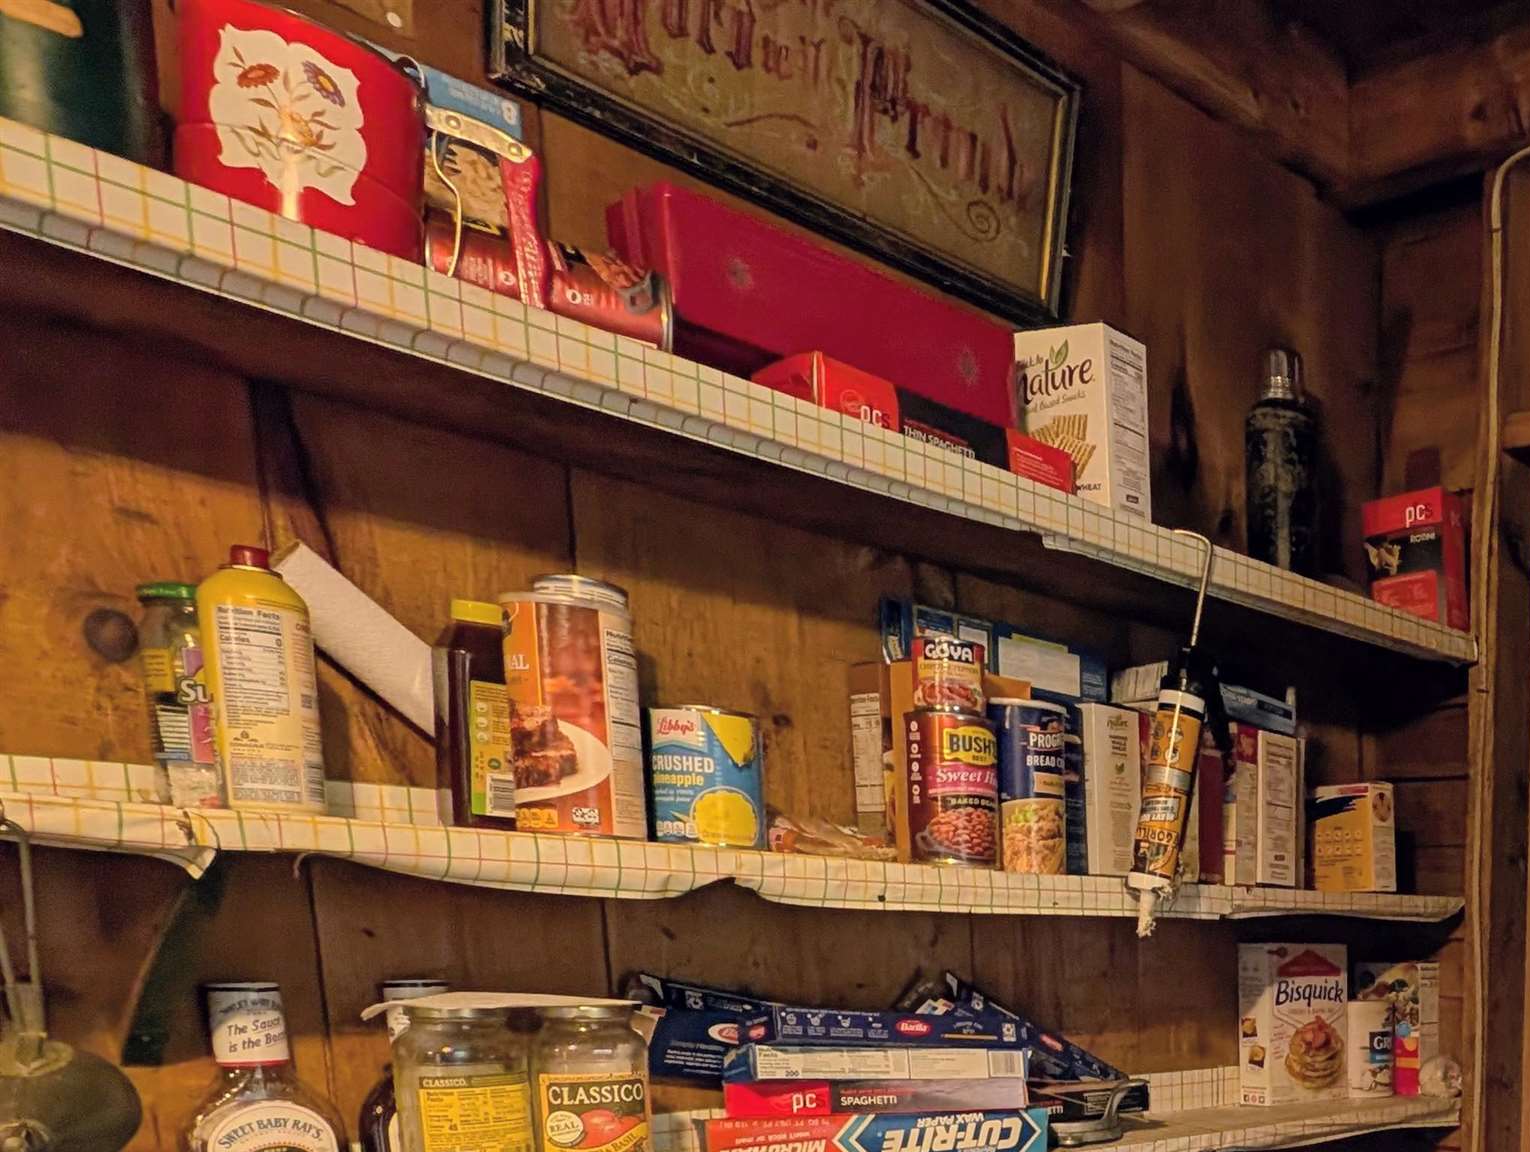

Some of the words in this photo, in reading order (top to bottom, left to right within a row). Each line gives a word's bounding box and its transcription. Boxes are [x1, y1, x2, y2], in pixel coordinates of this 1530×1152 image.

[924, 643, 973, 662] GOYA
[652, 755, 714, 774] CRUSHED
[1026, 755, 1056, 768] BREAD
[936, 767, 982, 783] Sweet
[1275, 978, 1344, 1007] Bisquick
[227, 1023, 248, 1036] The
[229, 1041, 238, 1053] is
[242, 1037, 262, 1051] the
[549, 1083, 643, 1105] CLASSICO
[840, 1095, 898, 1106] SPAGHETTI
[916, 1115, 955, 1128] PAPER
[956, 1112, 985, 1125] WAX
[218, 1122, 255, 1149] SWEET
[256, 1117, 290, 1130] BABY
[612, 1133, 639, 1152] BASIL
